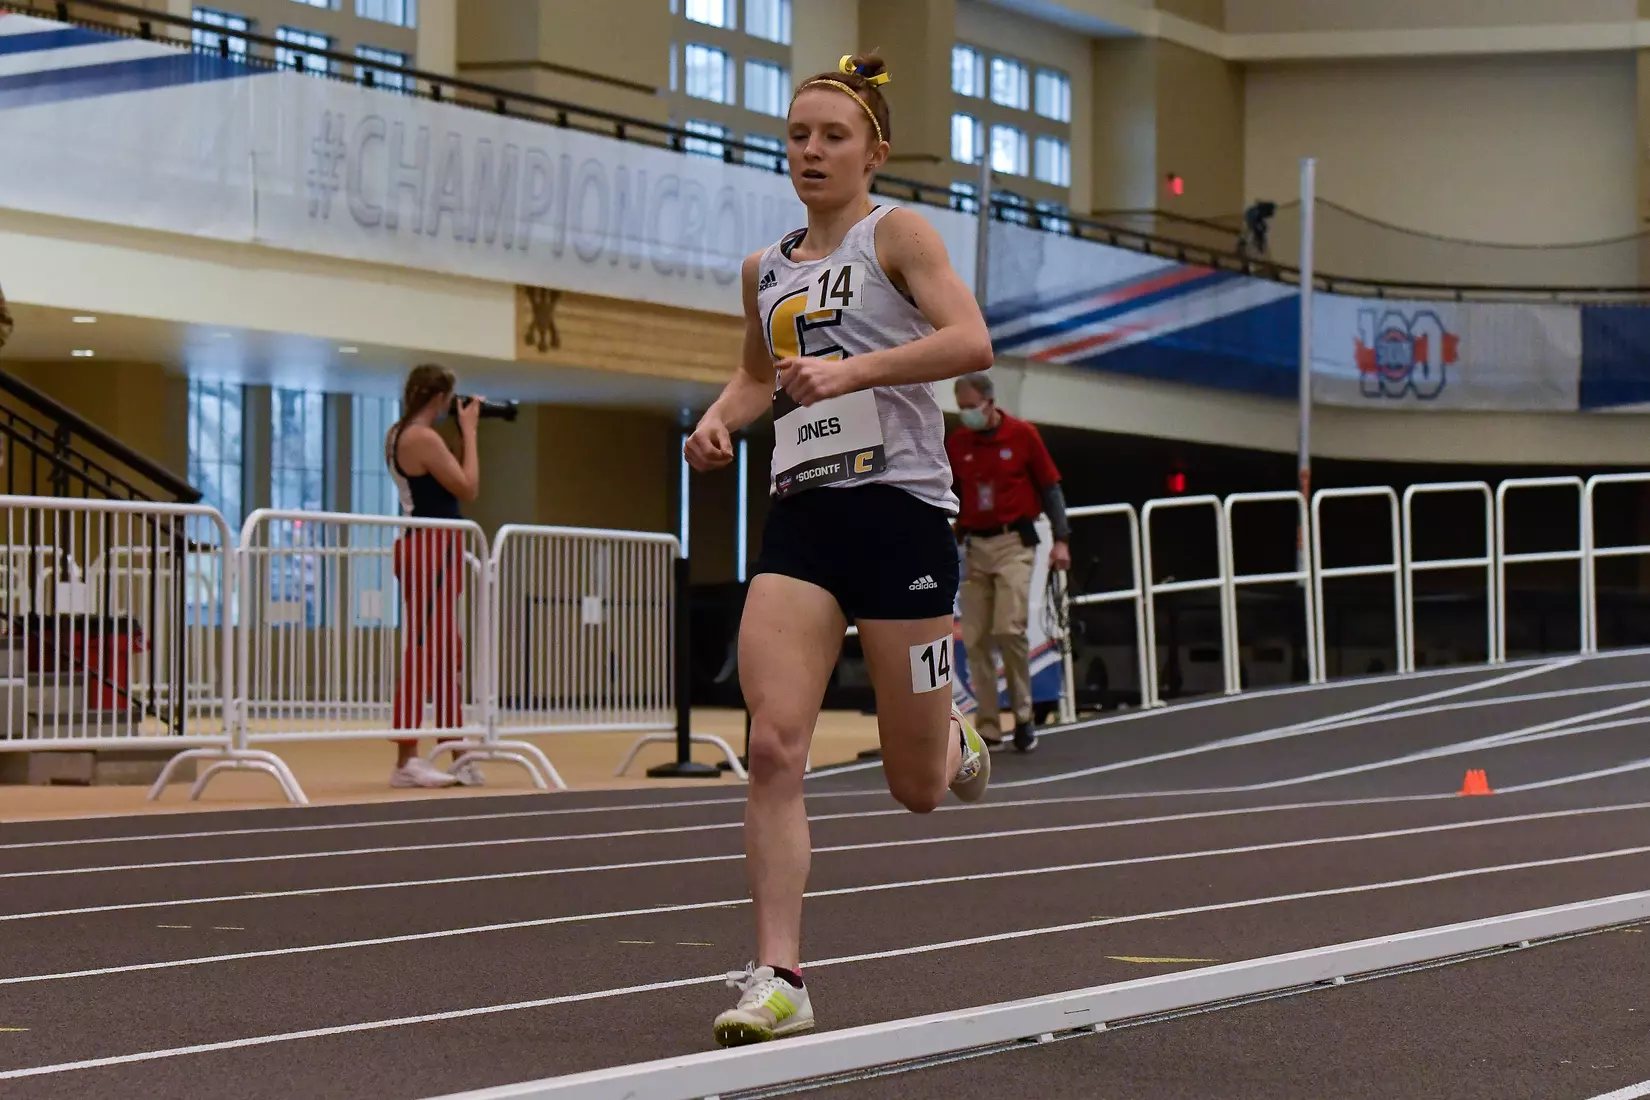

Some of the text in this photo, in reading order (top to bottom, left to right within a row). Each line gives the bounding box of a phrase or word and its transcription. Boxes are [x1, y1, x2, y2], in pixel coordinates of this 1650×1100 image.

[307, 107, 806, 286] #CHAMPIONCROW
[817, 265, 853, 308] 14
[1357, 308, 1446, 399] 100
[796, 416, 842, 446] JONES
[908, 581, 939, 591] adidas
[920, 639, 951, 689] 14
